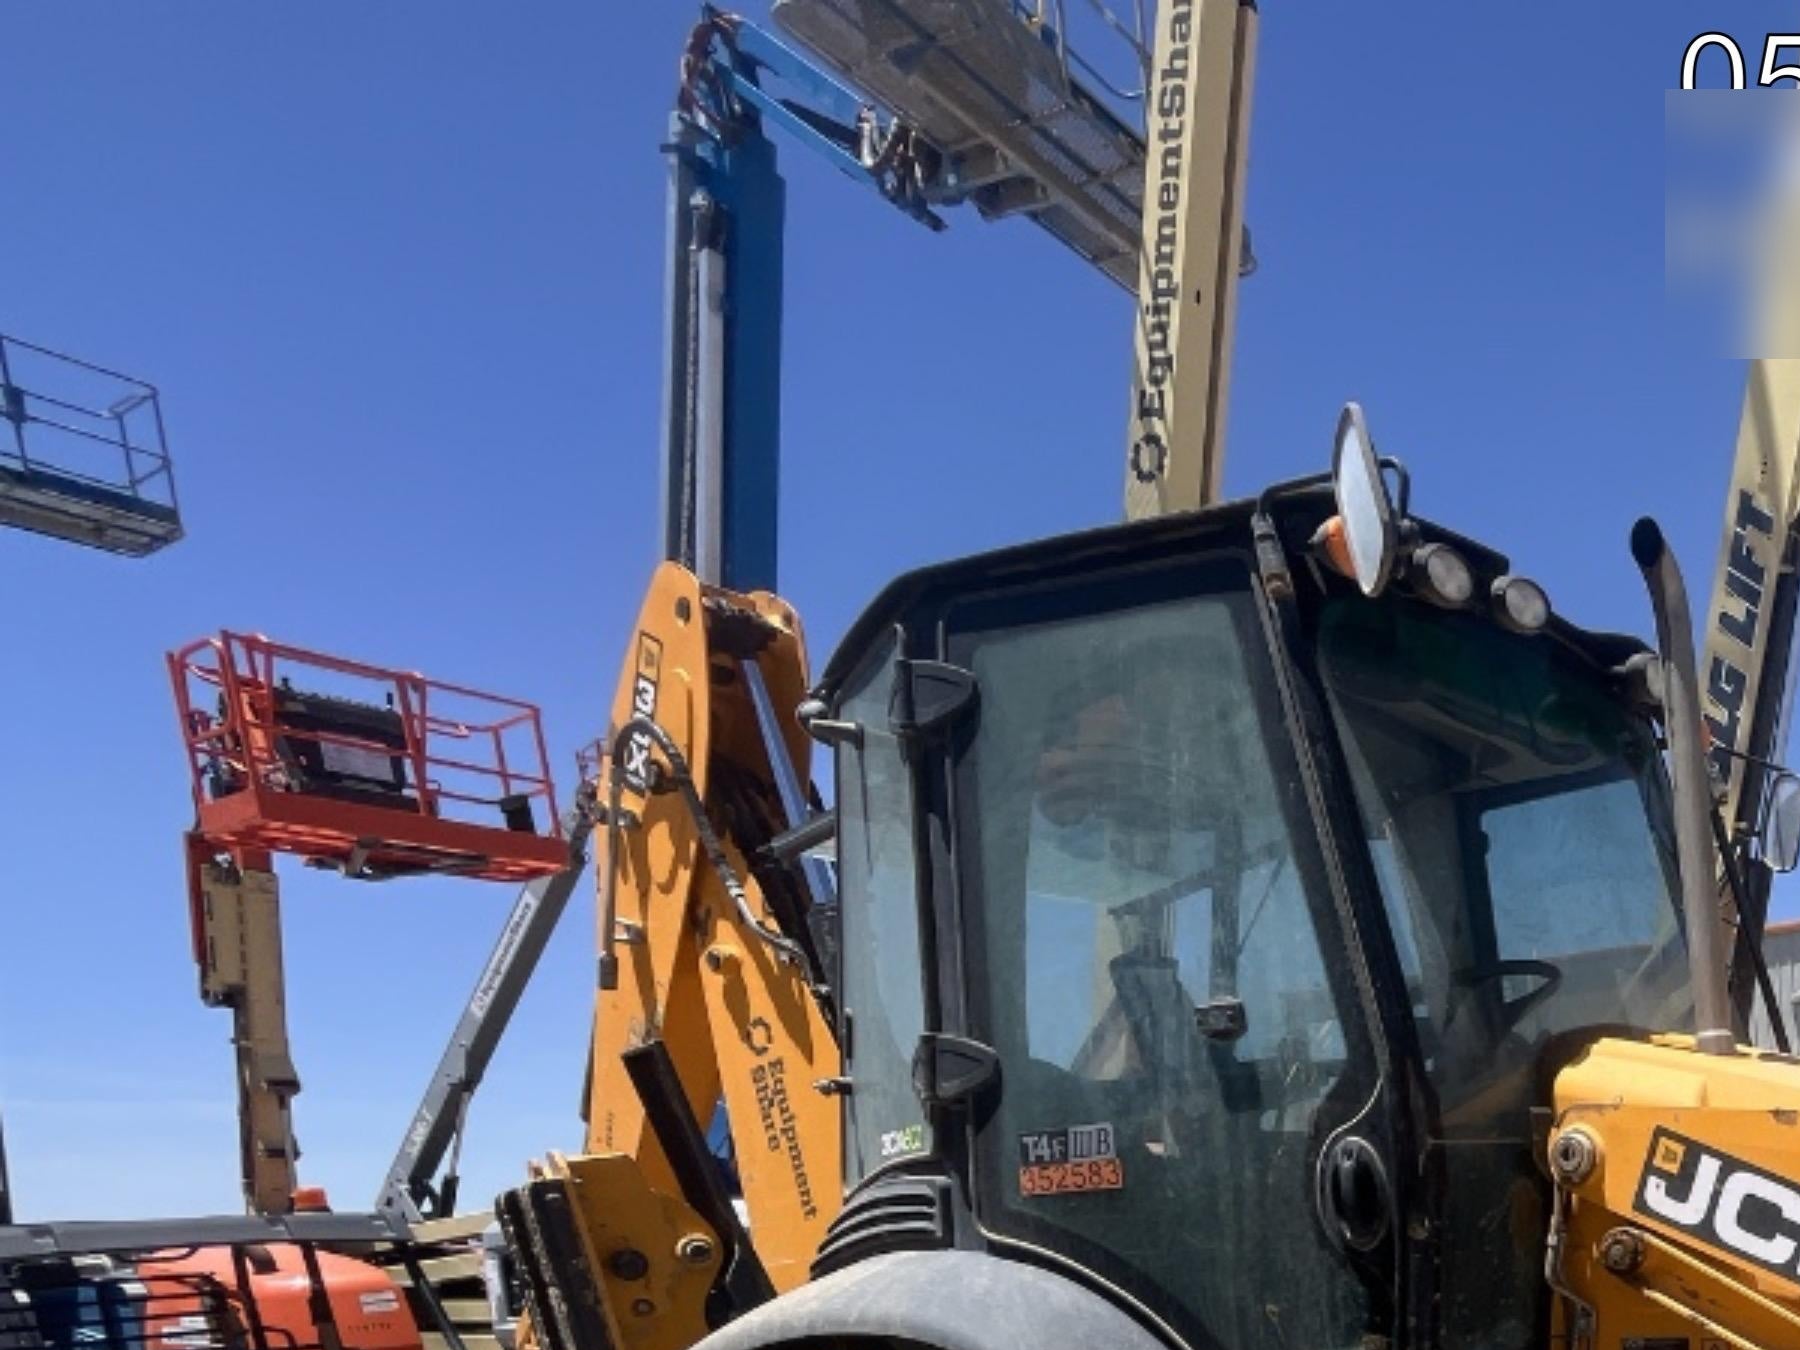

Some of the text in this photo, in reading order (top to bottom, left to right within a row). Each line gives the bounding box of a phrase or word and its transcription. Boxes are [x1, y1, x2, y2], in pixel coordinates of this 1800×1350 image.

[1718, 488, 1776, 648] LIFT
[750, 1064, 782, 1152] Share
[769, 1056, 817, 1220] Equipment
[1022, 1161, 1121, 1192] 352583
